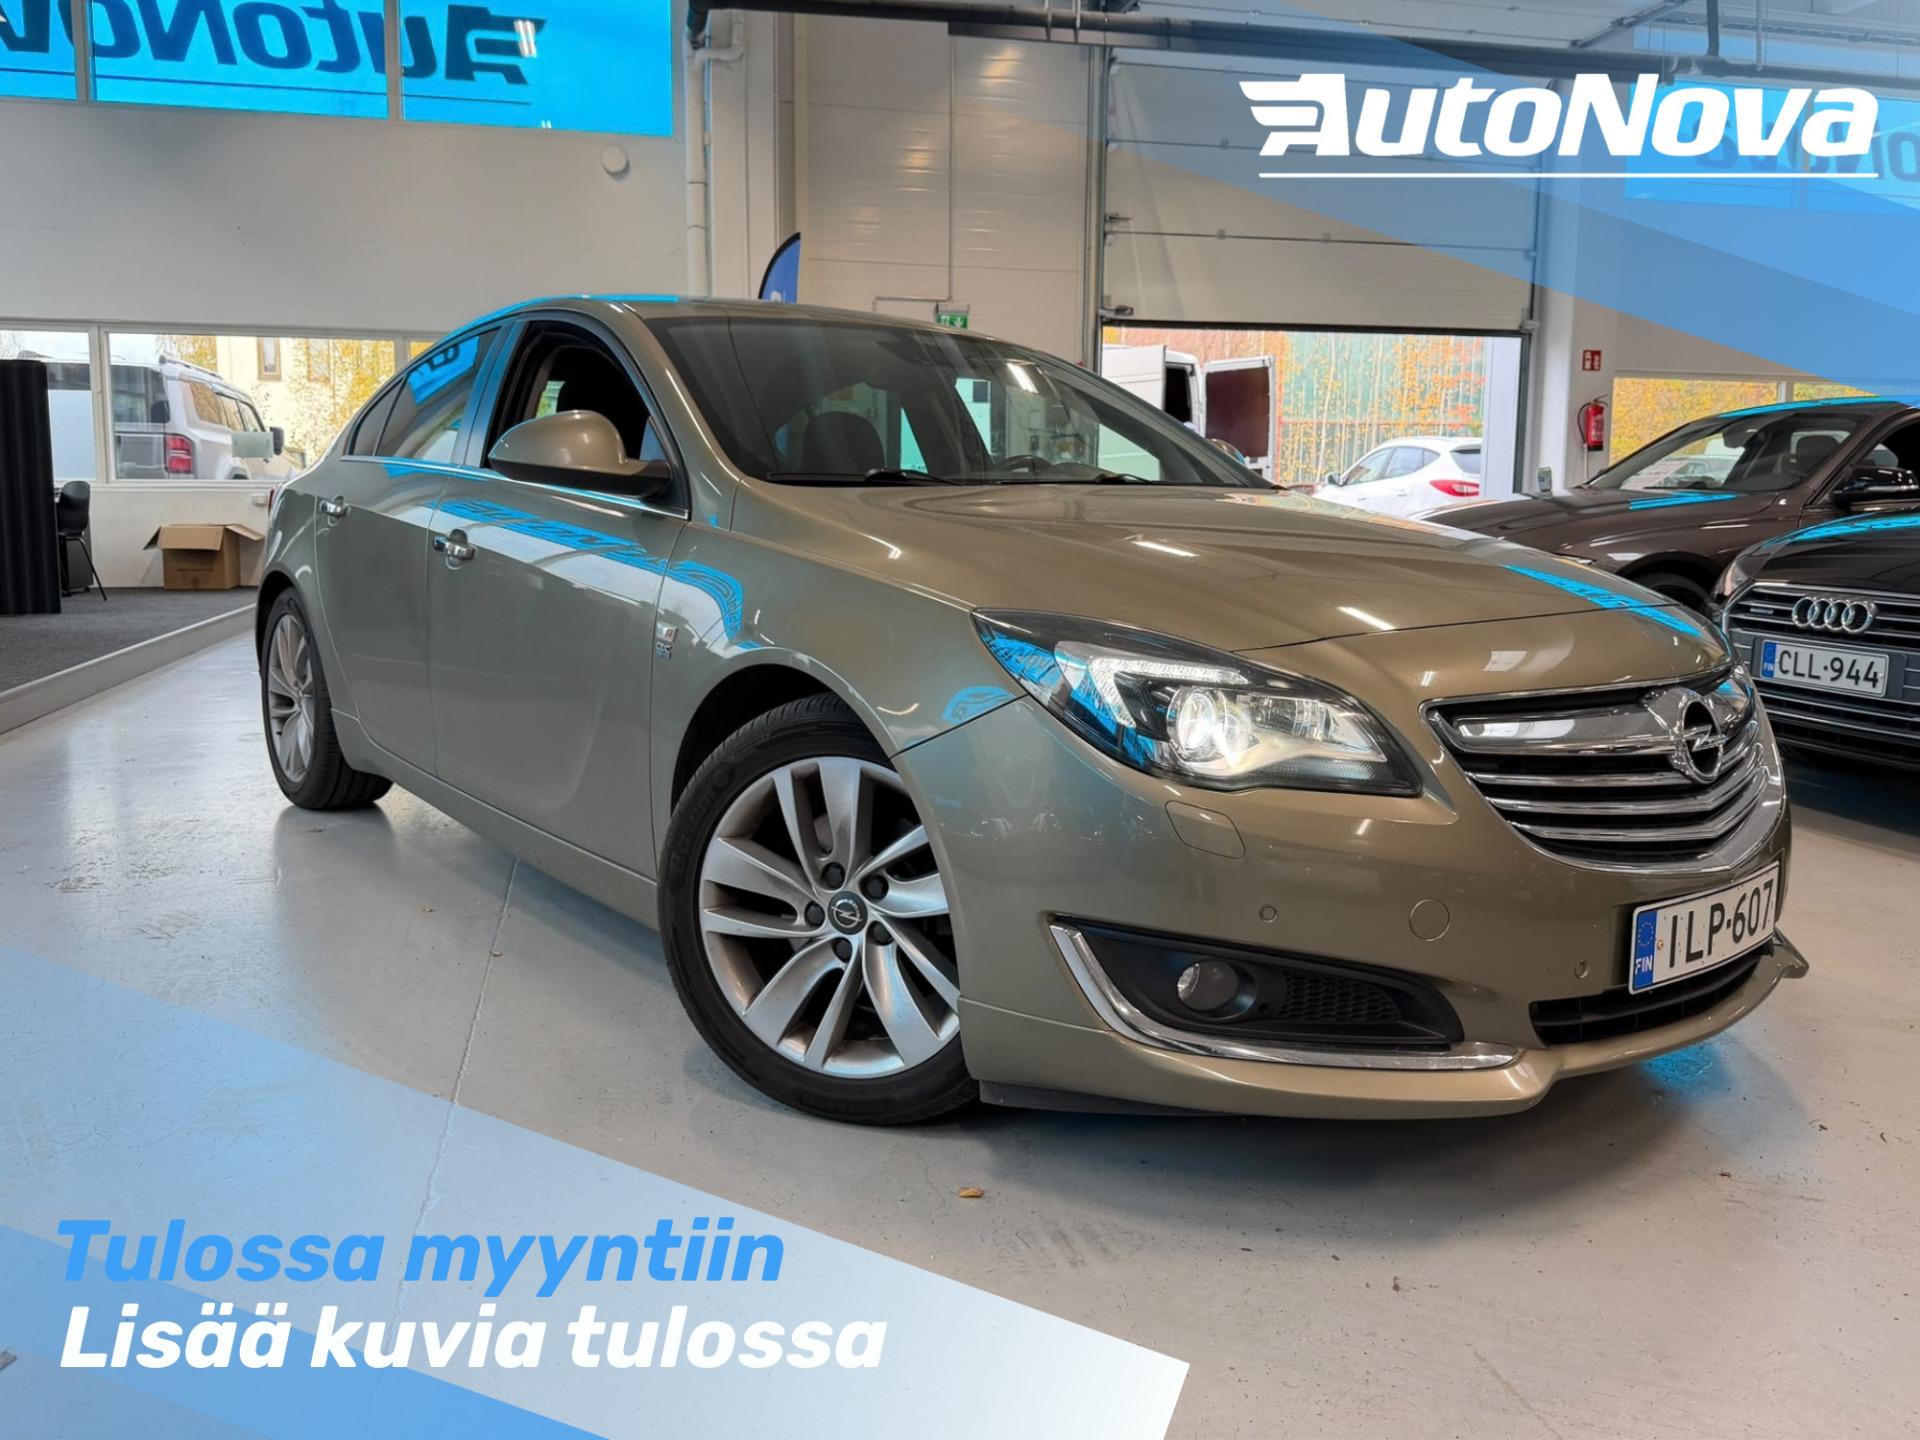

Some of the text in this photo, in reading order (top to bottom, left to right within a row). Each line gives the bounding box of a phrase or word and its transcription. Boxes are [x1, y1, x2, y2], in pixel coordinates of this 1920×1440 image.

[1779, 649, 1879, 689] CLL-944
[1669, 878, 1774, 968] ILP-607
[1634, 955, 1653, 975] FIN
